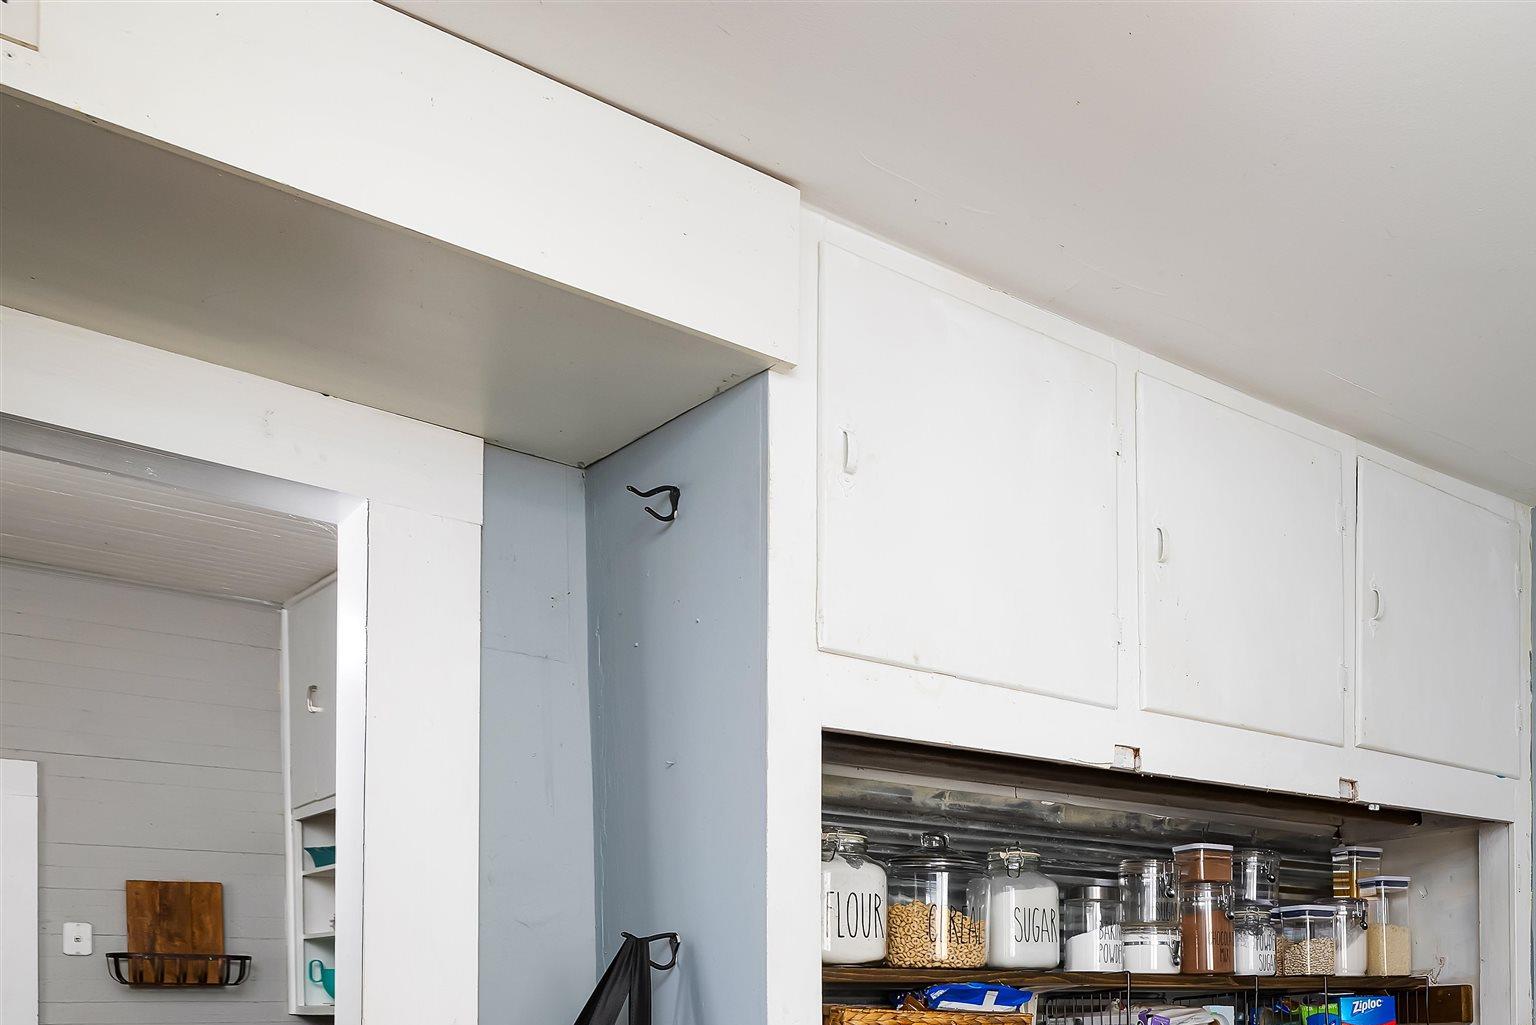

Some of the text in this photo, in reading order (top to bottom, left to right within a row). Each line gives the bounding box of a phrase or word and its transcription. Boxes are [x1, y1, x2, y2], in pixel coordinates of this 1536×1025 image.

[826, 891, 885, 939] FLOUR
[929, 904, 984, 944] CREAL
[1014, 906, 1058, 943] SUGAR
[1352, 998, 1382, 1014] Ziploc
